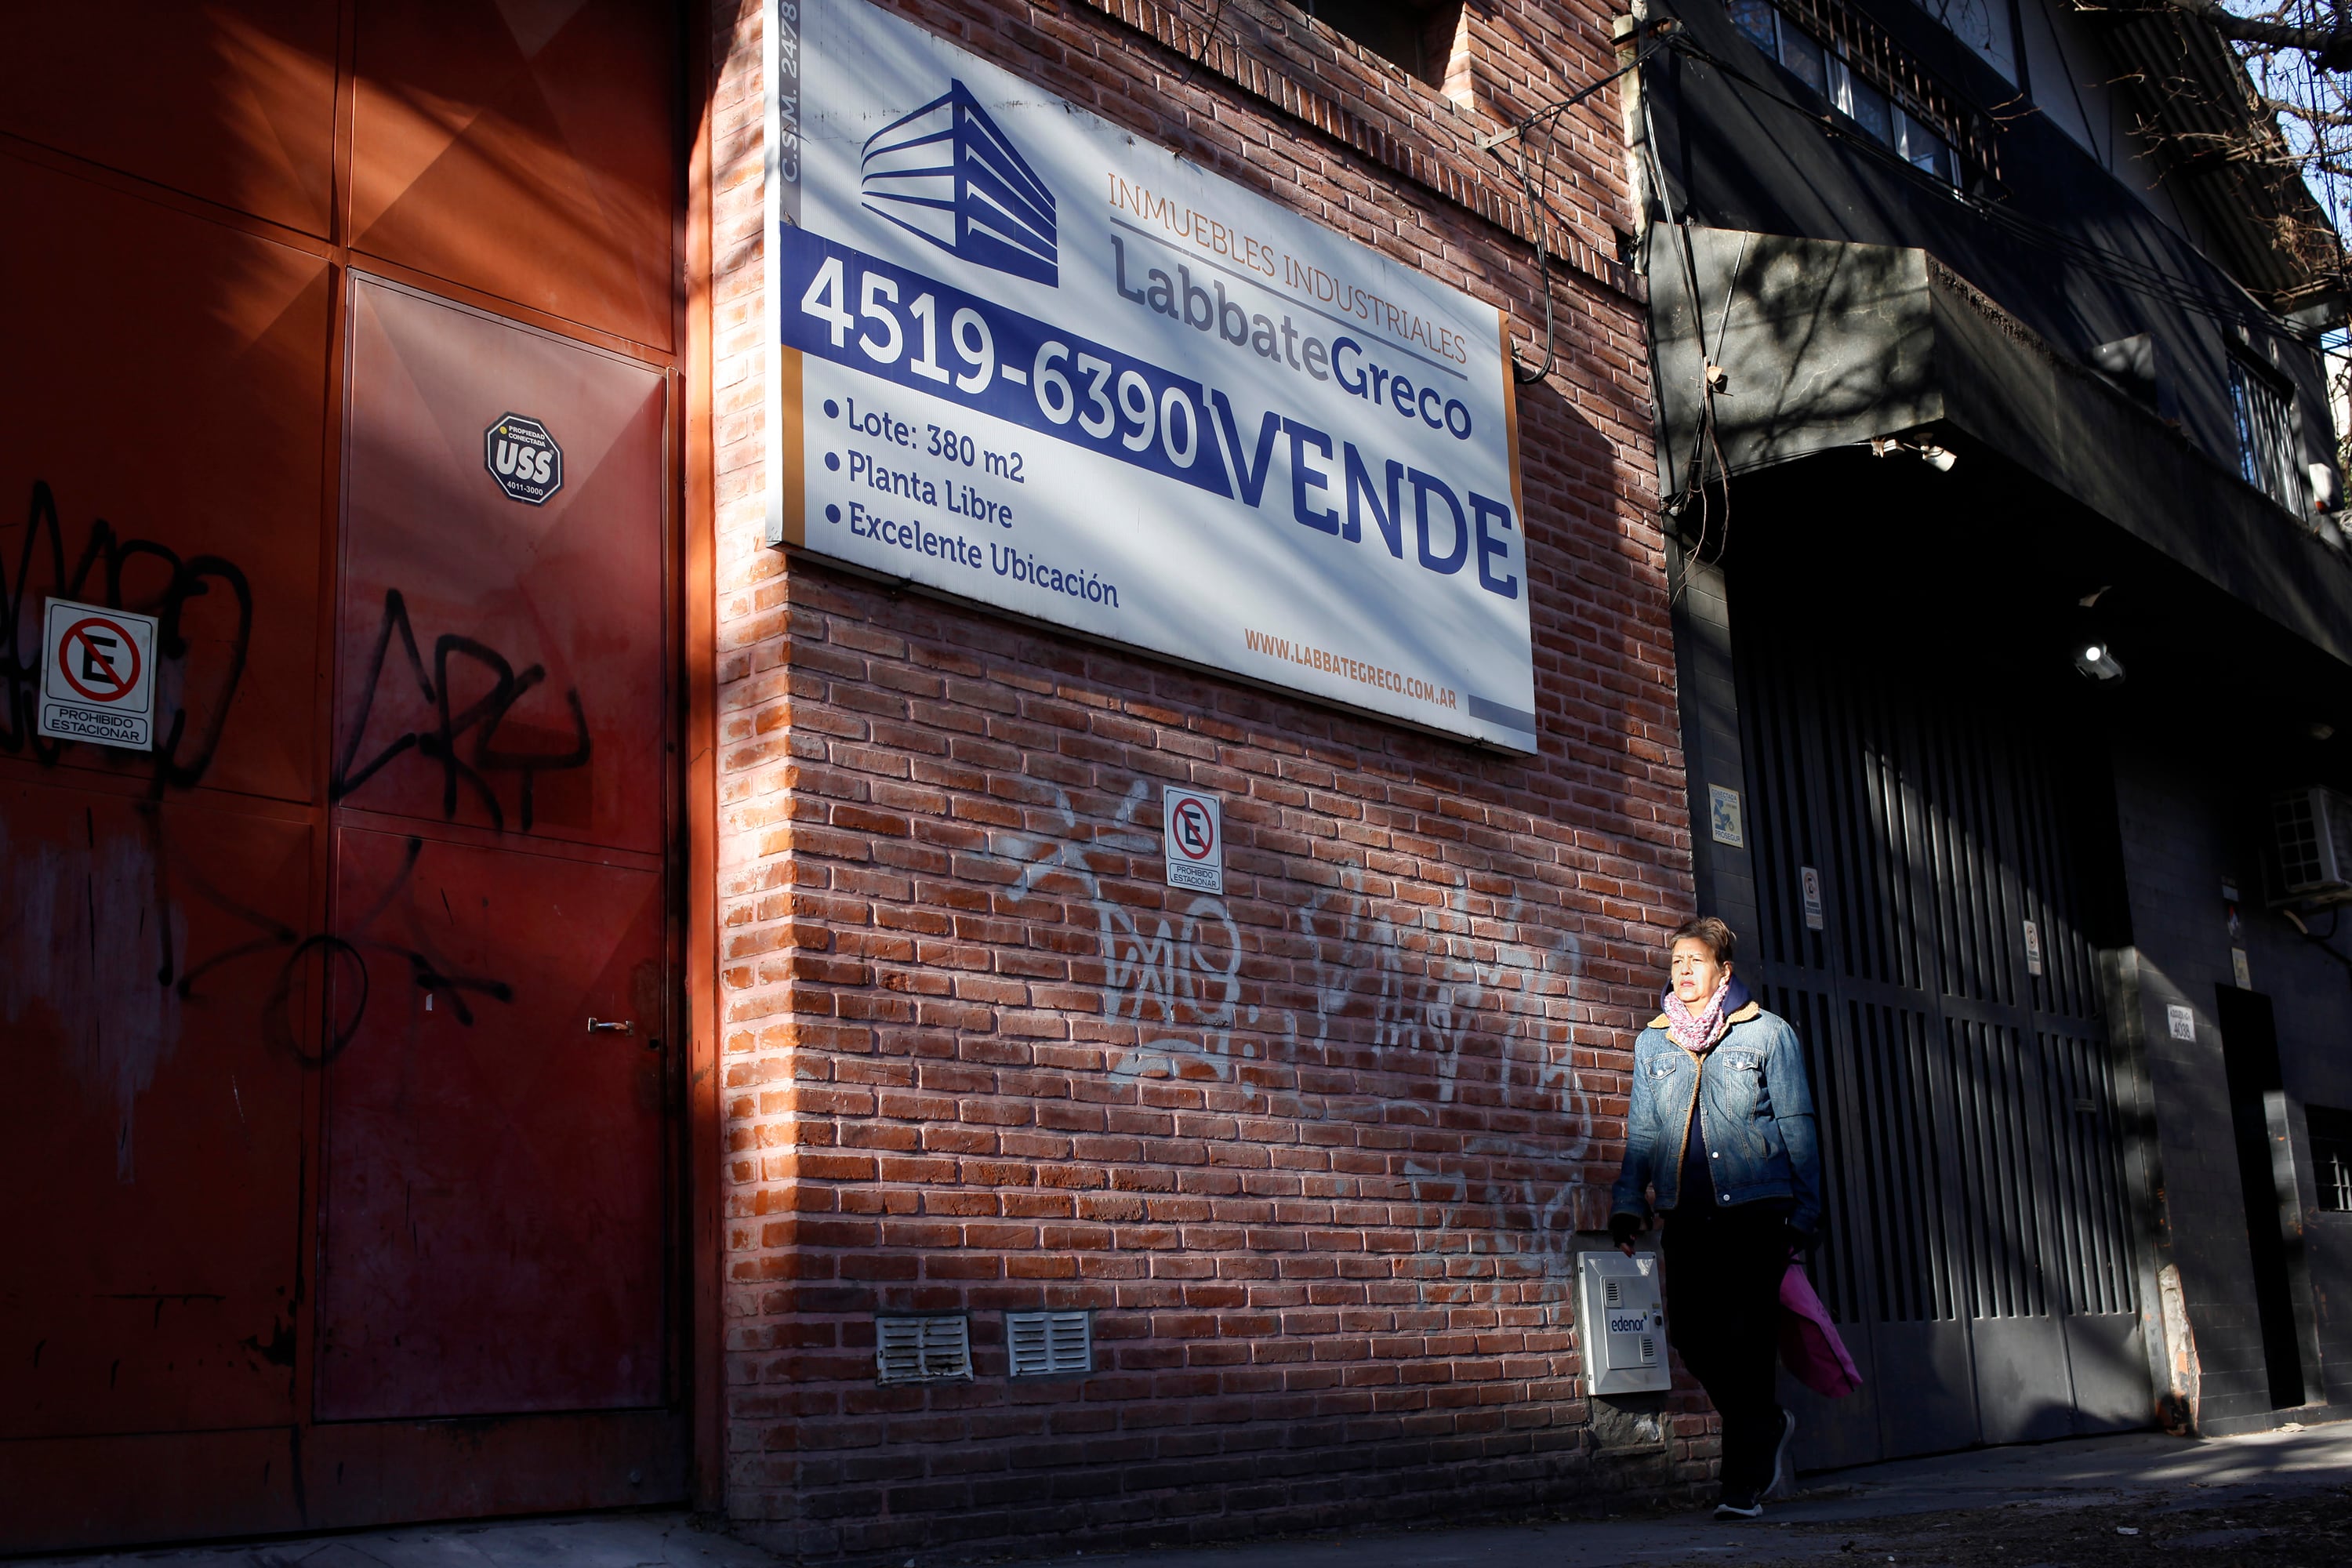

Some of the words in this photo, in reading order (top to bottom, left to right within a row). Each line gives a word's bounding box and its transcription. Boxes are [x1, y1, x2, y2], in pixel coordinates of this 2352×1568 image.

[781, 1, 798, 78] 2478
[781, 89, 798, 182] C.S.M.
[1108, 172, 1276, 277] INMUEBLES
[1283, 255, 1468, 364] INDUSTRIALES
[800, 256, 1197, 469] 4519-6390
[1111, 234, 1472, 440] LabbateGreco
[496, 439, 553, 484] USS
[509, 426, 545, 439] PROPIEDAD
[509, 433, 546, 447] CONECTADA
[847, 397, 916, 449] Lote:
[927, 423, 975, 466] 380
[984, 450, 1025, 483] m2
[507, 481, 543, 495] 4011-3000
[848, 449, 937, 506] Planta
[946, 480, 1013, 528] Libre
[1211, 389, 1518, 600] VENDE
[848, 501, 982, 569] Excelente
[990, 543, 1119, 608] Ubicación
[1244, 628, 1457, 710] WWW.LABBATEGRECO.COM.AR
[52, 720, 139, 740] ESTACIONAR
[60, 708, 133, 728] PROHIBIDO
[1715, 830, 1740, 842] PROSEGUR
[1174, 873, 1217, 887] ESTACIONAR
[1177, 866, 1214, 879] PROHIBIDO
[1612, 1316, 1644, 1331] edenor
